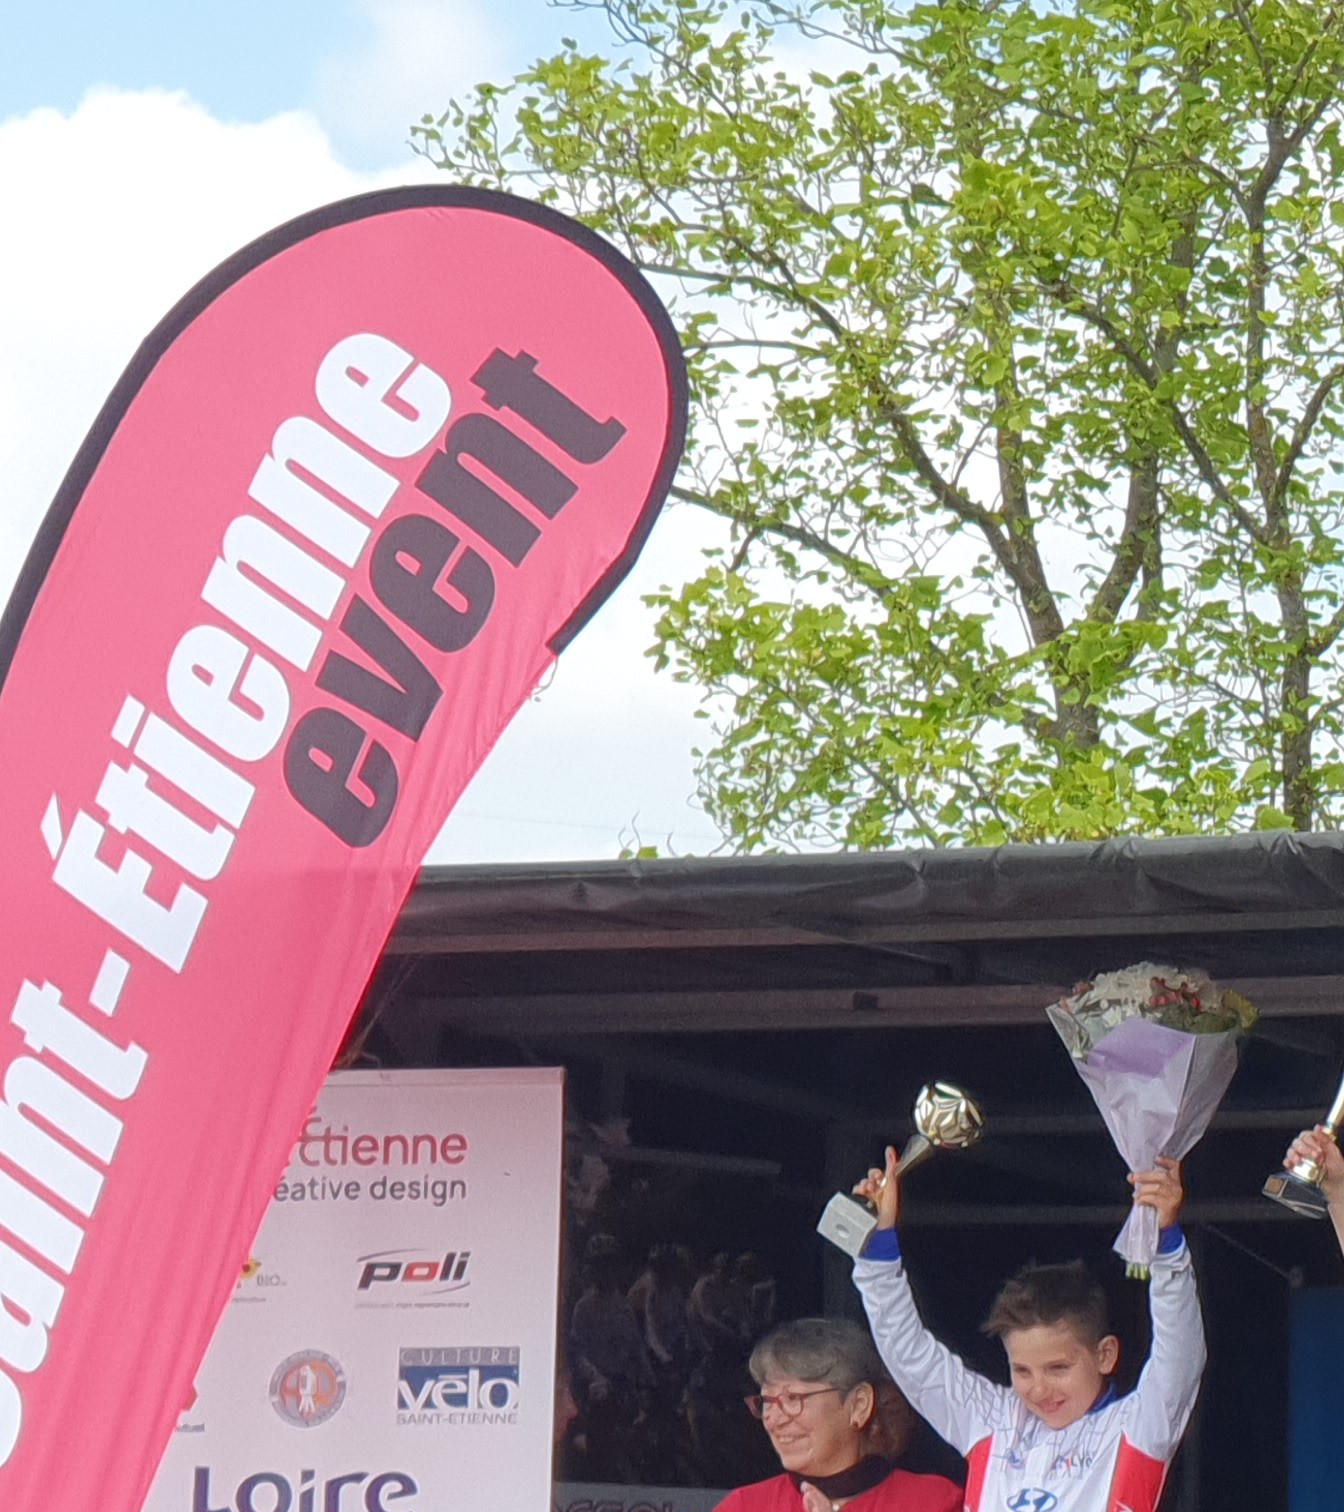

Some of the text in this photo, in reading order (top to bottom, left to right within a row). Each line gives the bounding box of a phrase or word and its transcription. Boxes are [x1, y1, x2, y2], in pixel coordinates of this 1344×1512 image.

[283, 346, 628, 848] event
[0, 332, 452, 1467] aint-Étienne
[369, 1173, 468, 1207] design
[357, 1251, 471, 1291] poli
[401, 1348, 519, 1365] CULTURE
